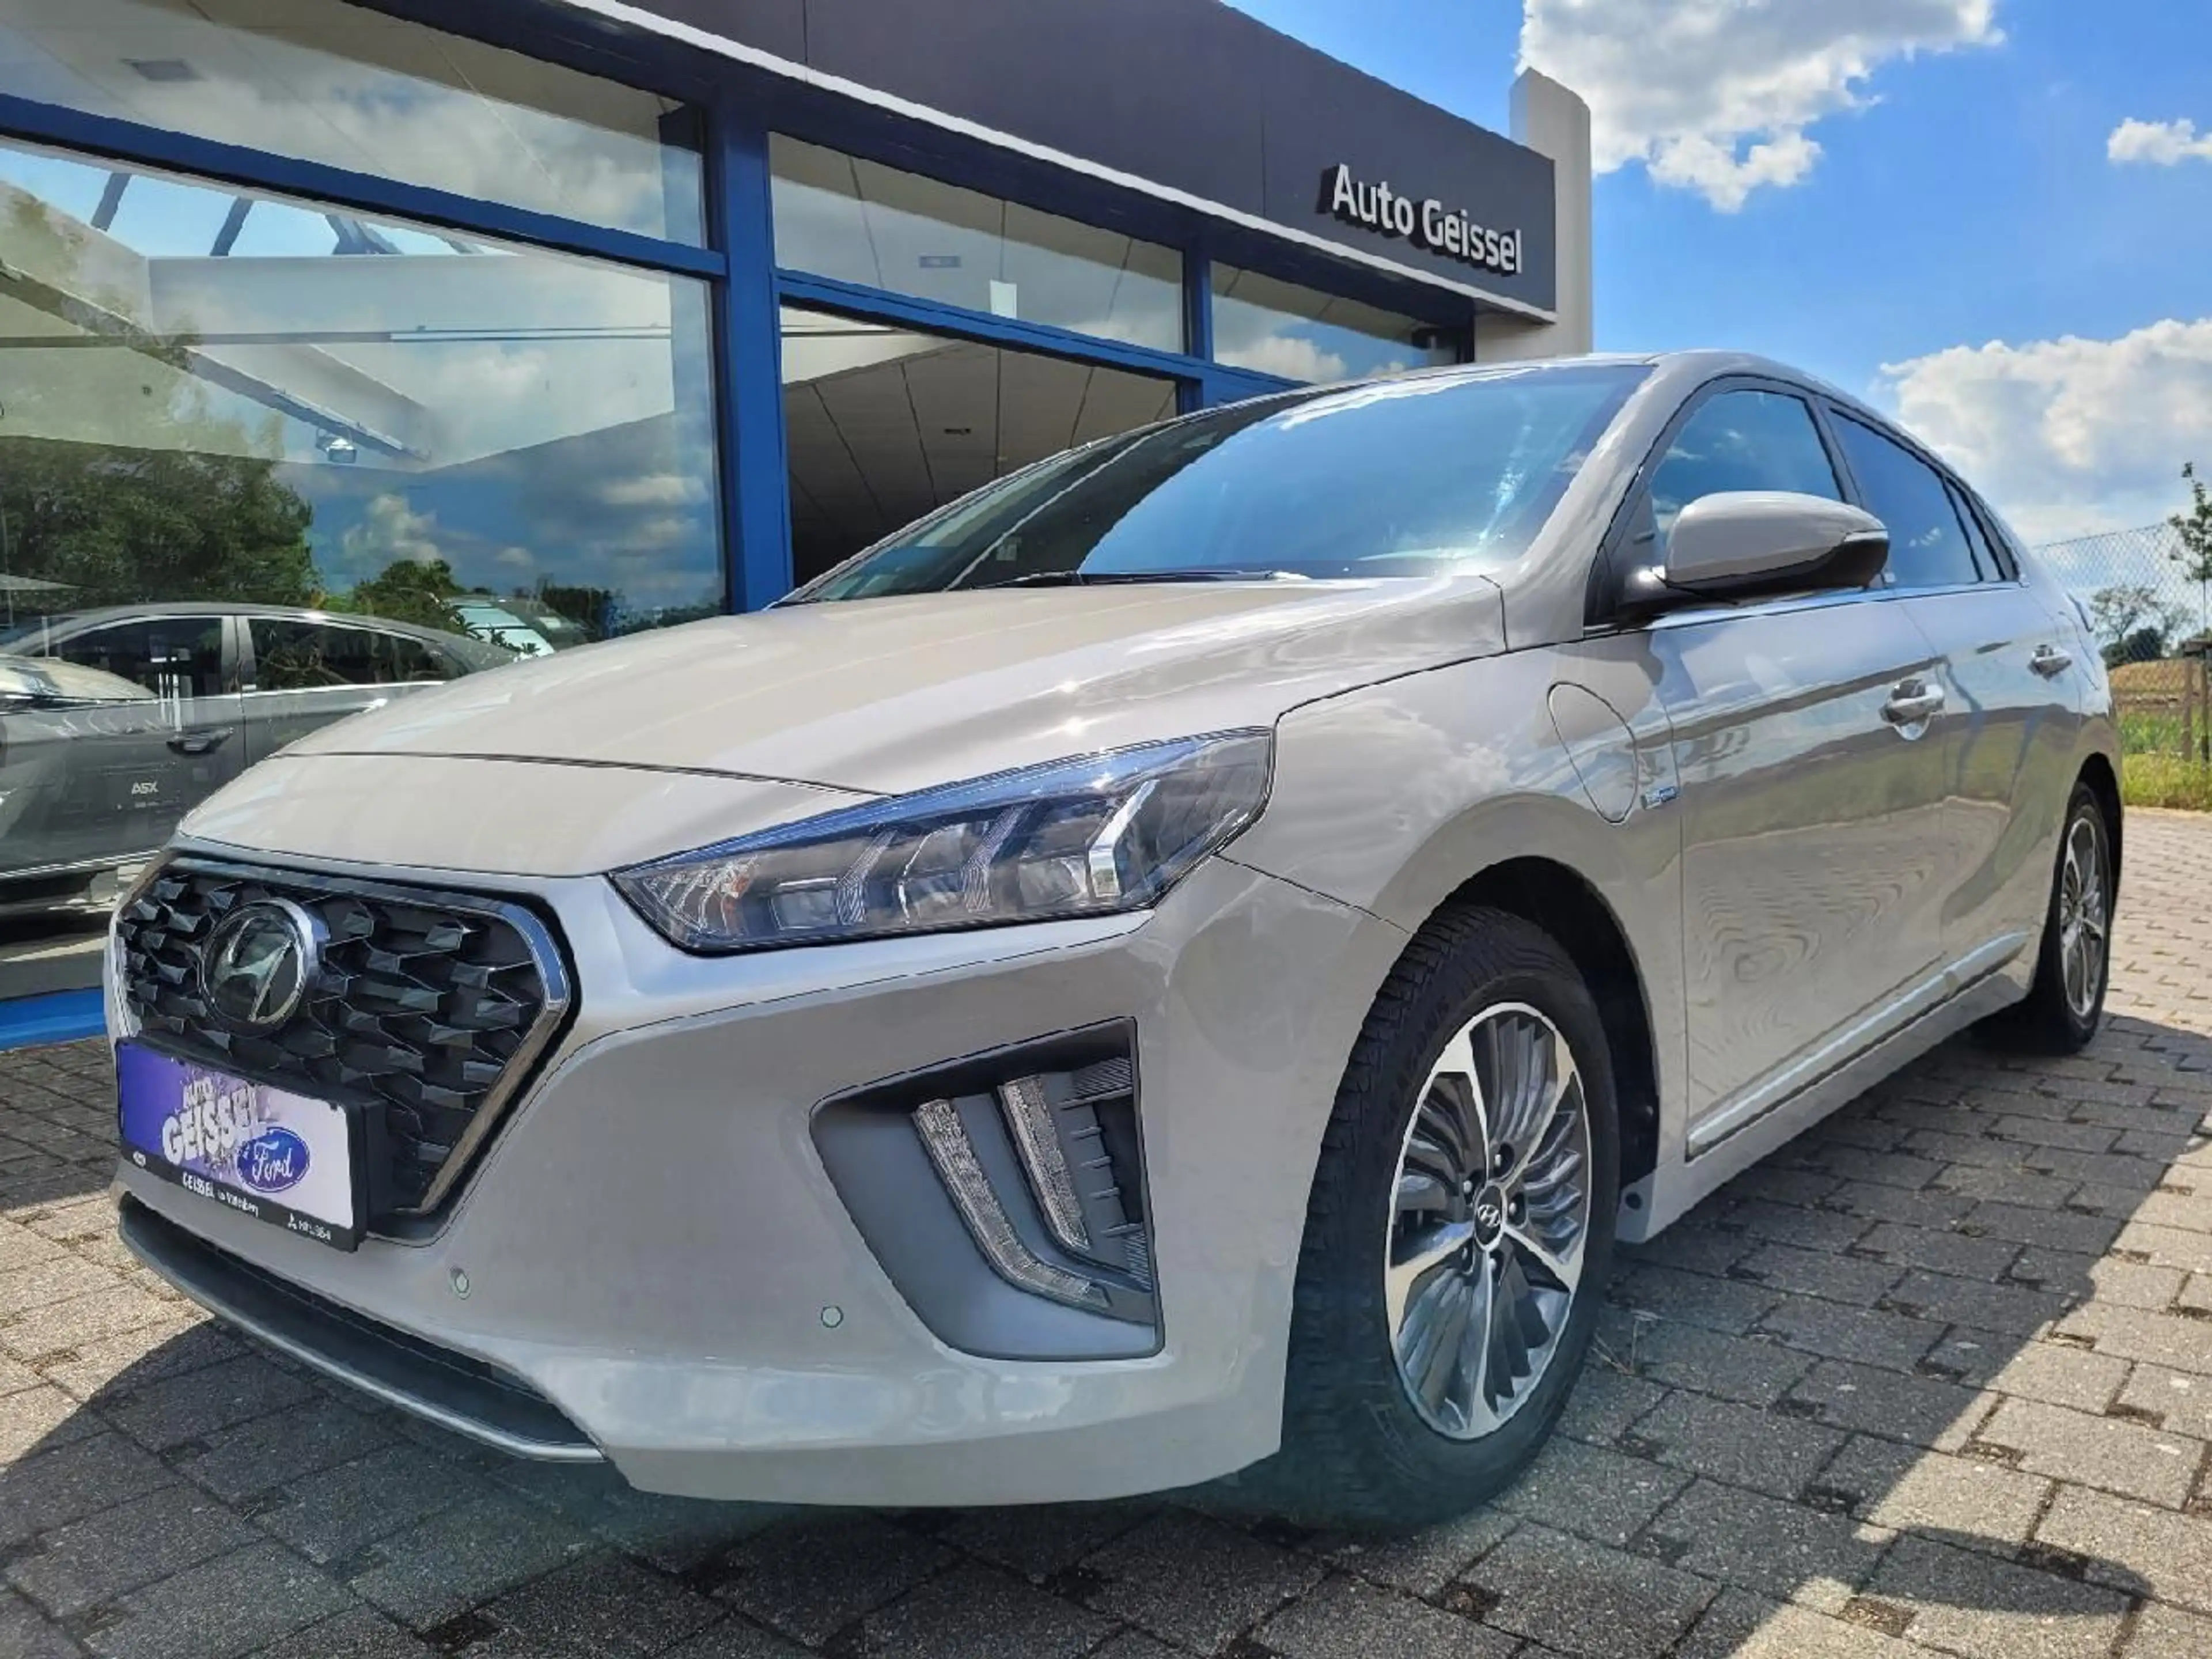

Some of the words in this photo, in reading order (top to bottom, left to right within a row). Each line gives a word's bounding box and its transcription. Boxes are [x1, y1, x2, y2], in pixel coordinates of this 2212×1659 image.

[1332, 163, 1414, 236] Auto
[1422, 198, 1522, 274] Geissel
[131, 781, 159, 795] ASX
[252, 1140, 294, 1183] Ford
